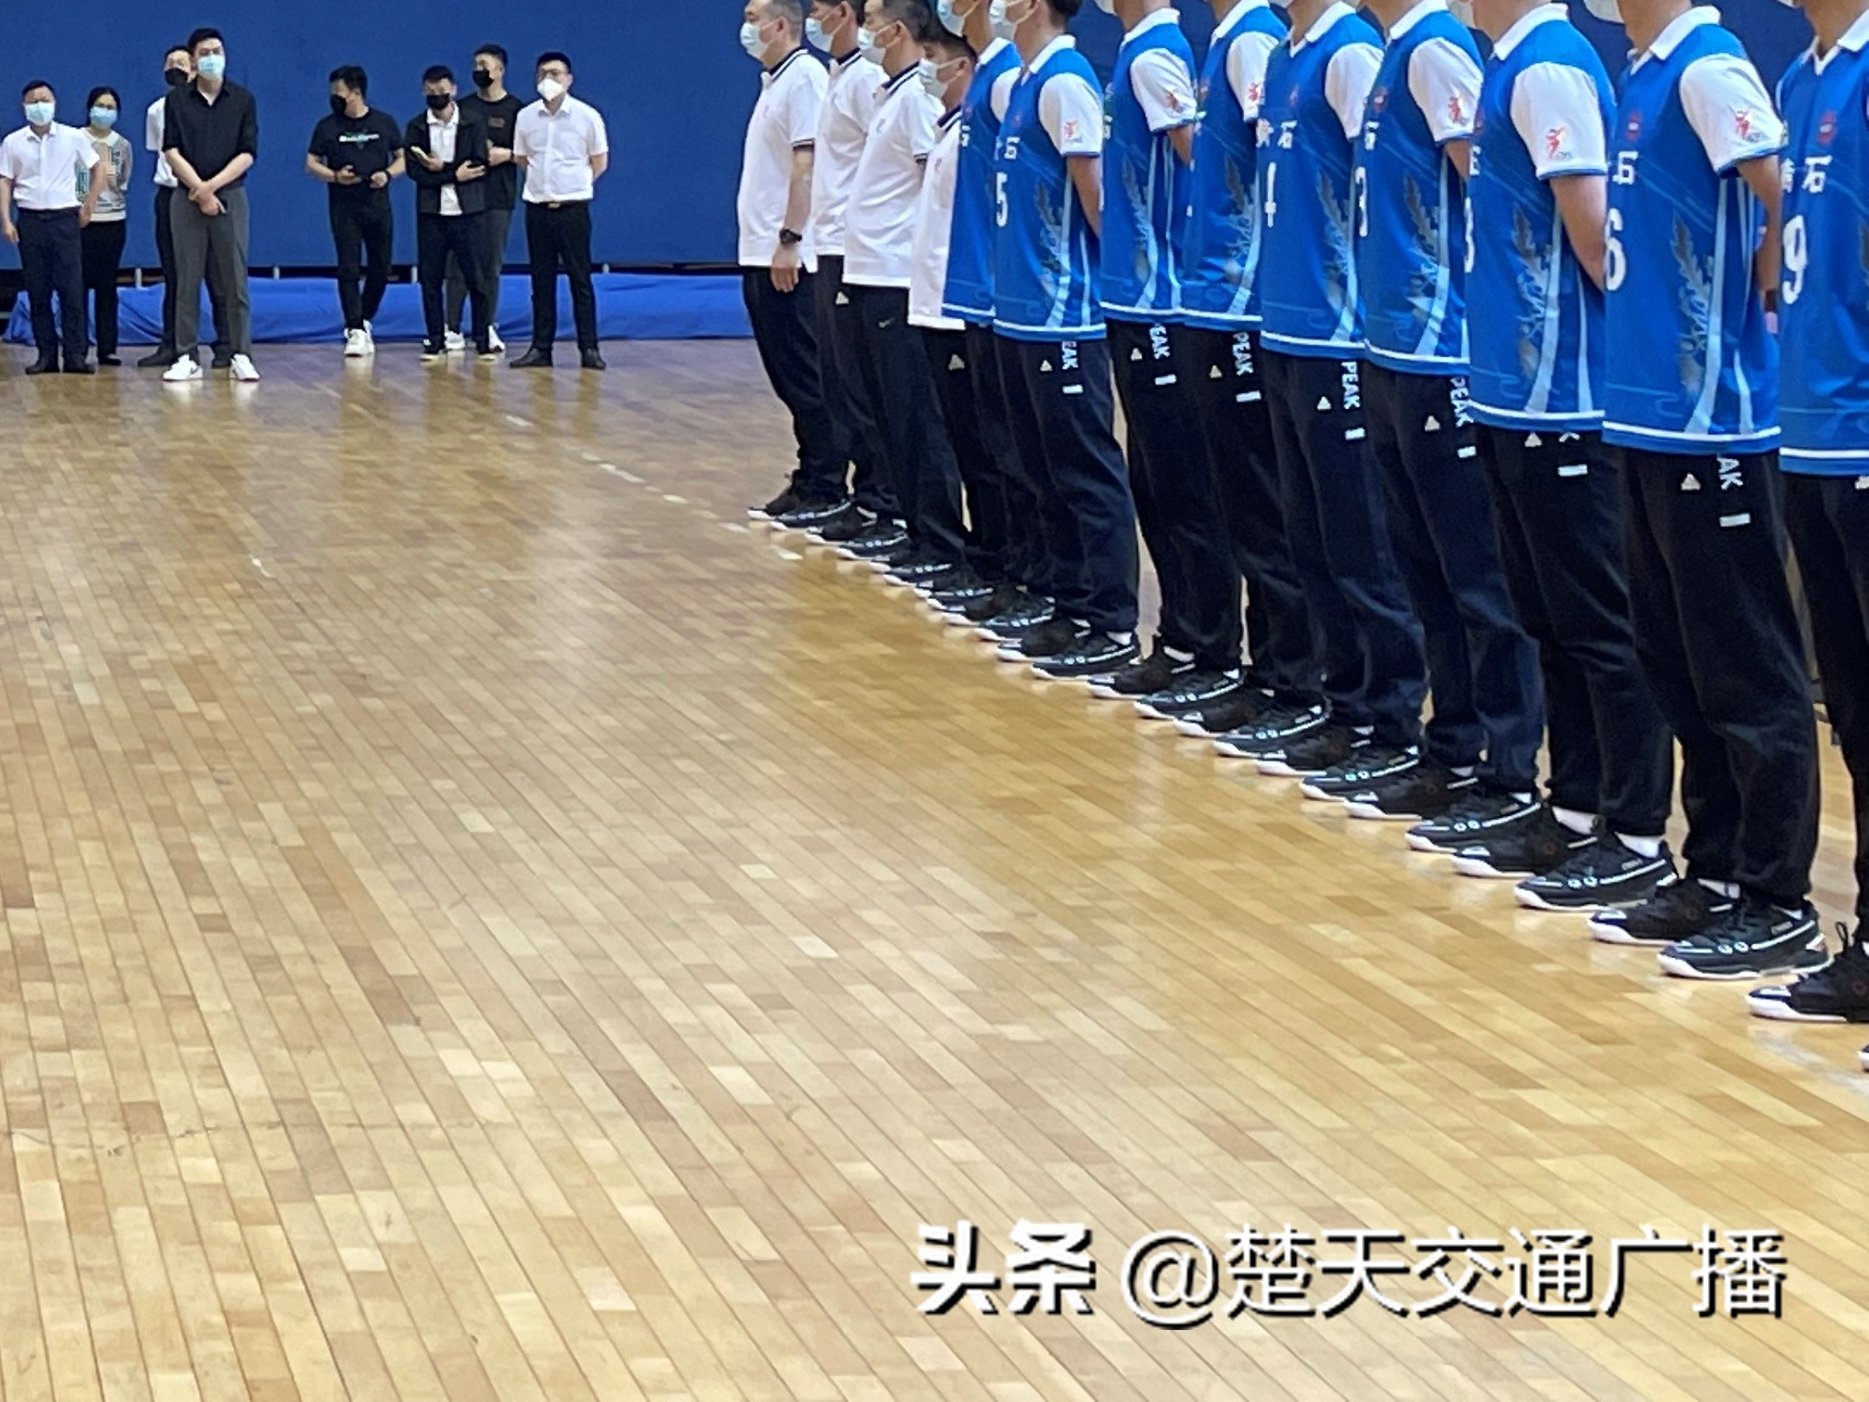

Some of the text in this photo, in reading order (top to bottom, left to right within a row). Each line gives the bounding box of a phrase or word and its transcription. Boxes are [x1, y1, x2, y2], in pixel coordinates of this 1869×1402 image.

[1604, 207, 1627, 291] 6
[1782, 214, 1808, 304] 9
[1062, 341, 1079, 370] EAK
[1149, 323, 1171, 360] EAK
[1232, 331, 1254, 376] PEAK
[1341, 361, 1361, 410] PEAK
[1717, 455, 1743, 490] AK
